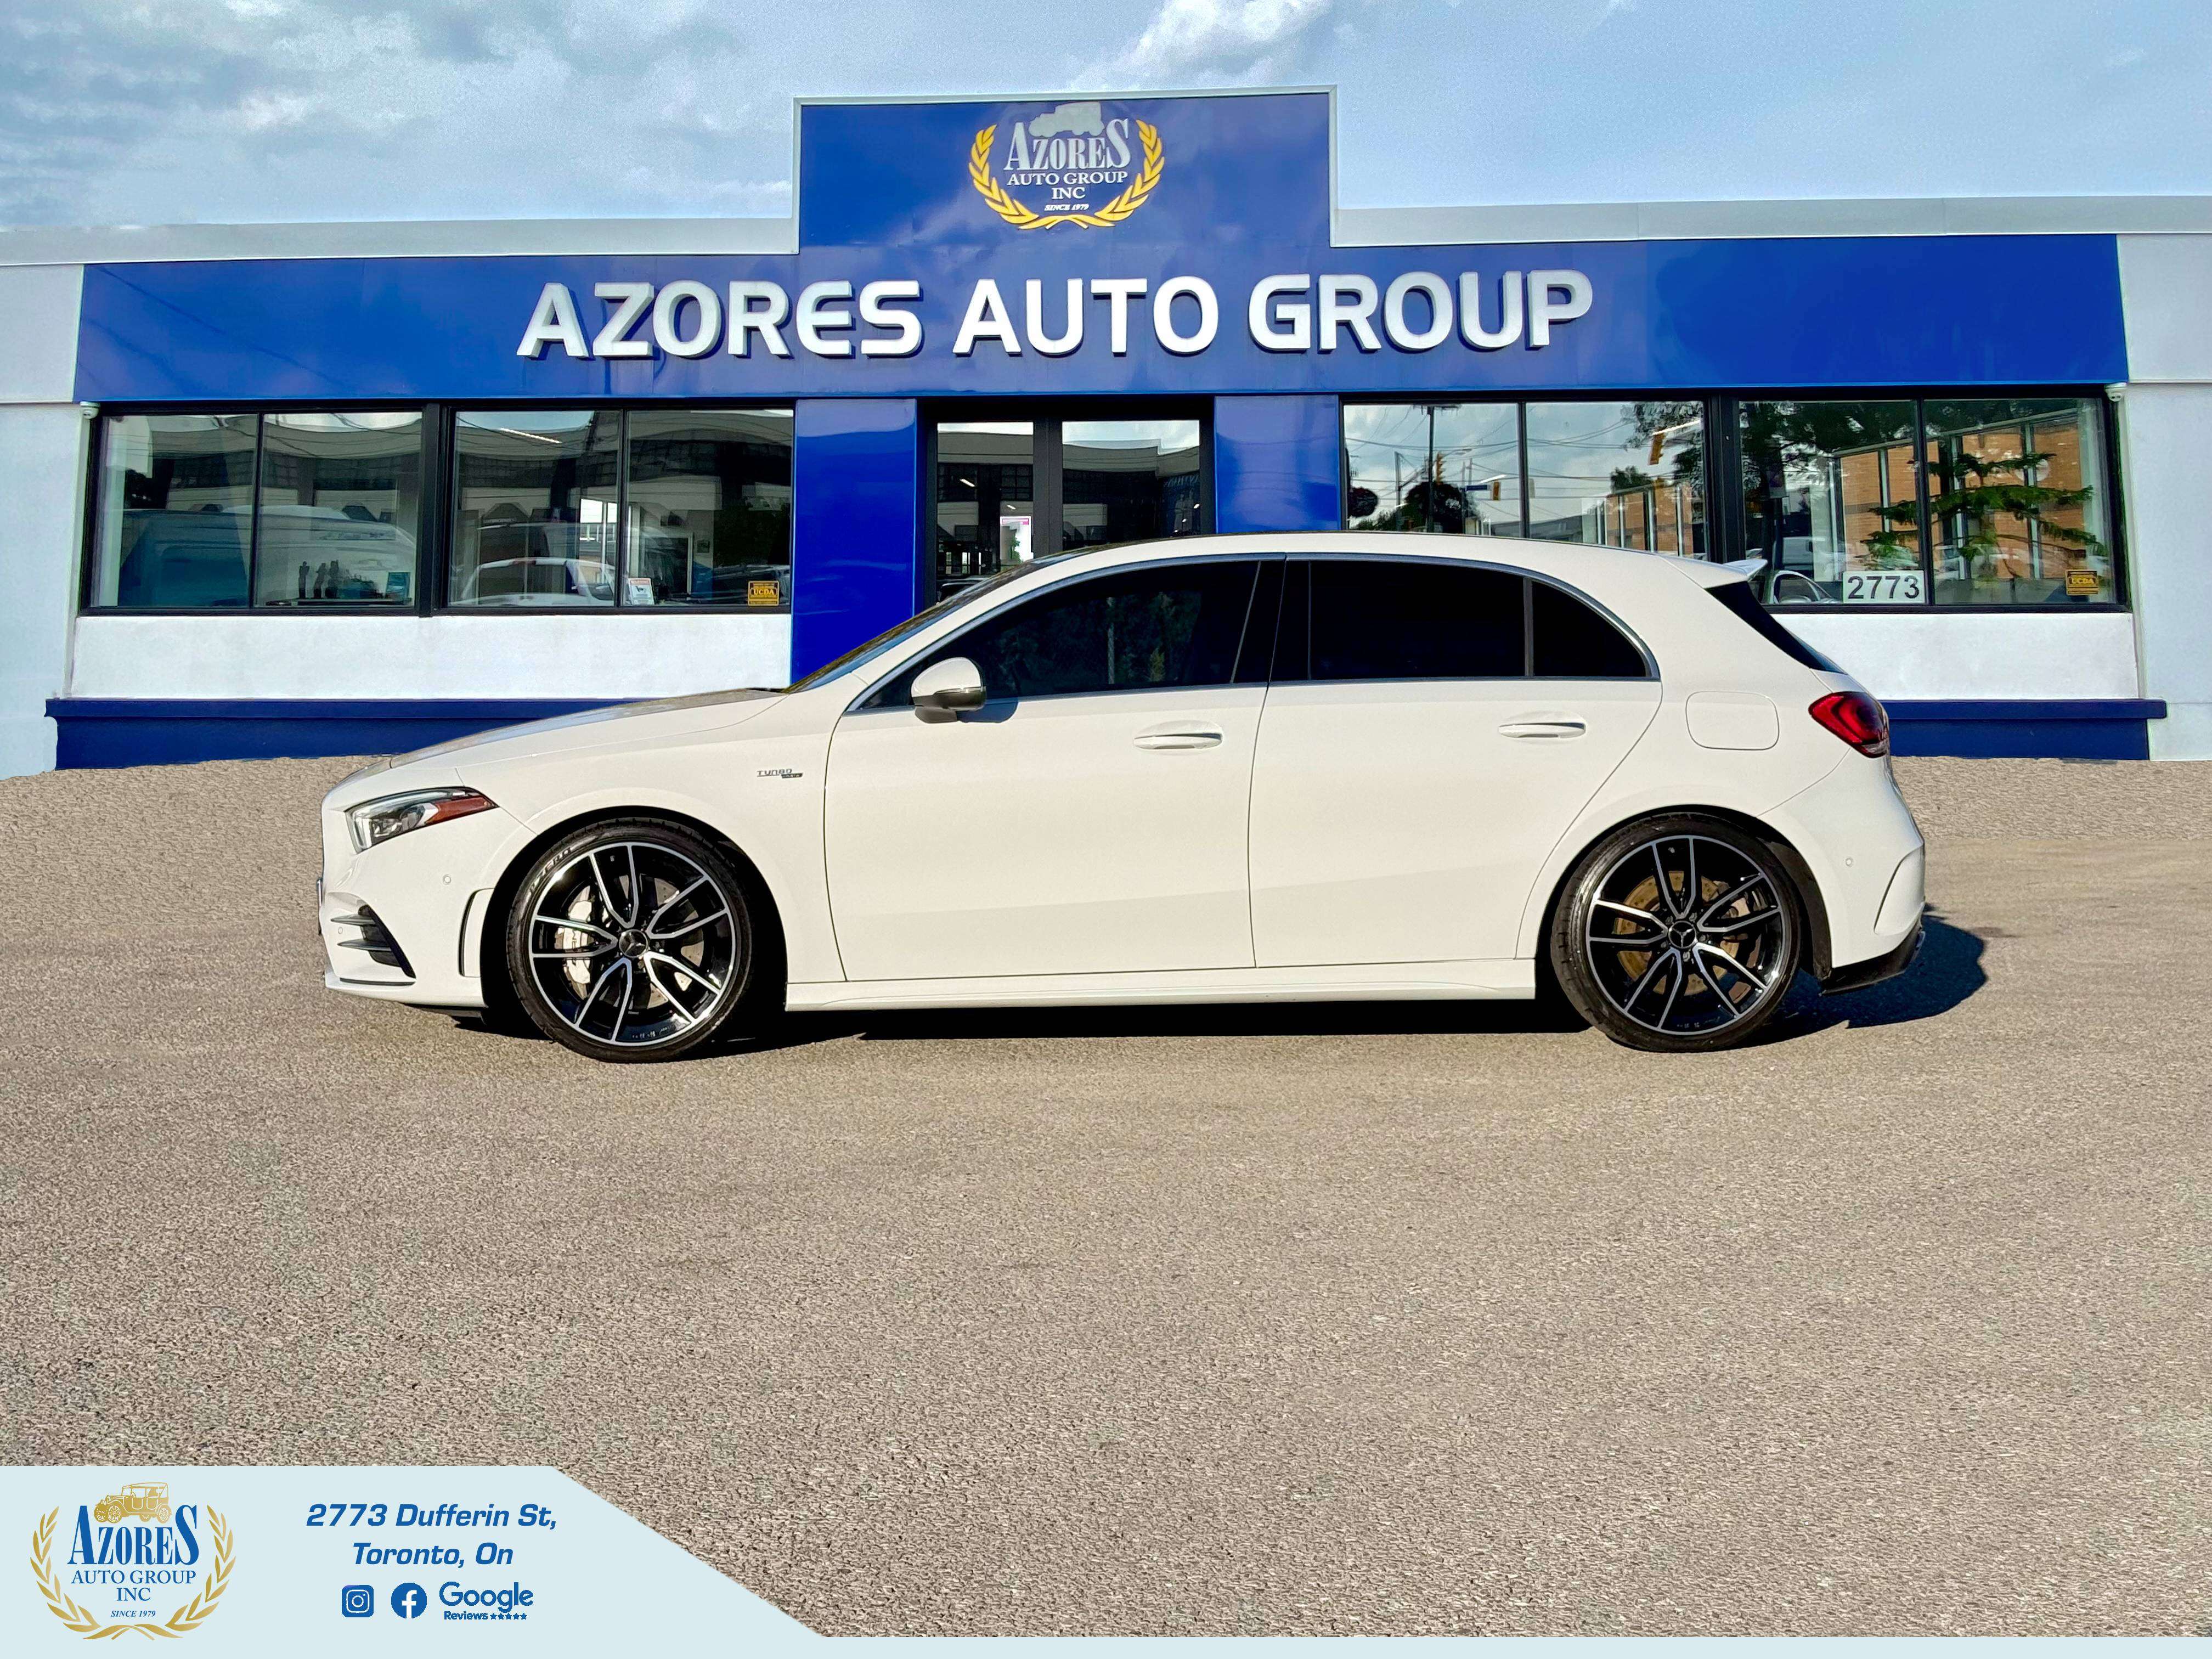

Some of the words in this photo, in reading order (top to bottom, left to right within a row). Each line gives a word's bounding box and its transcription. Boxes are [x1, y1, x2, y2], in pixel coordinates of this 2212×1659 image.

[1003, 118, 1131, 171] AZORES
[1006, 172, 1060, 187] AUTO
[1063, 171, 1128, 185] GROUP
[1051, 187, 1086, 200] INC
[516, 280, 923, 358] AZORES
[952, 276, 1218, 357] AUTO
[1249, 269, 1593, 351] GROUP
[1847, 575, 1920, 599] 2773
